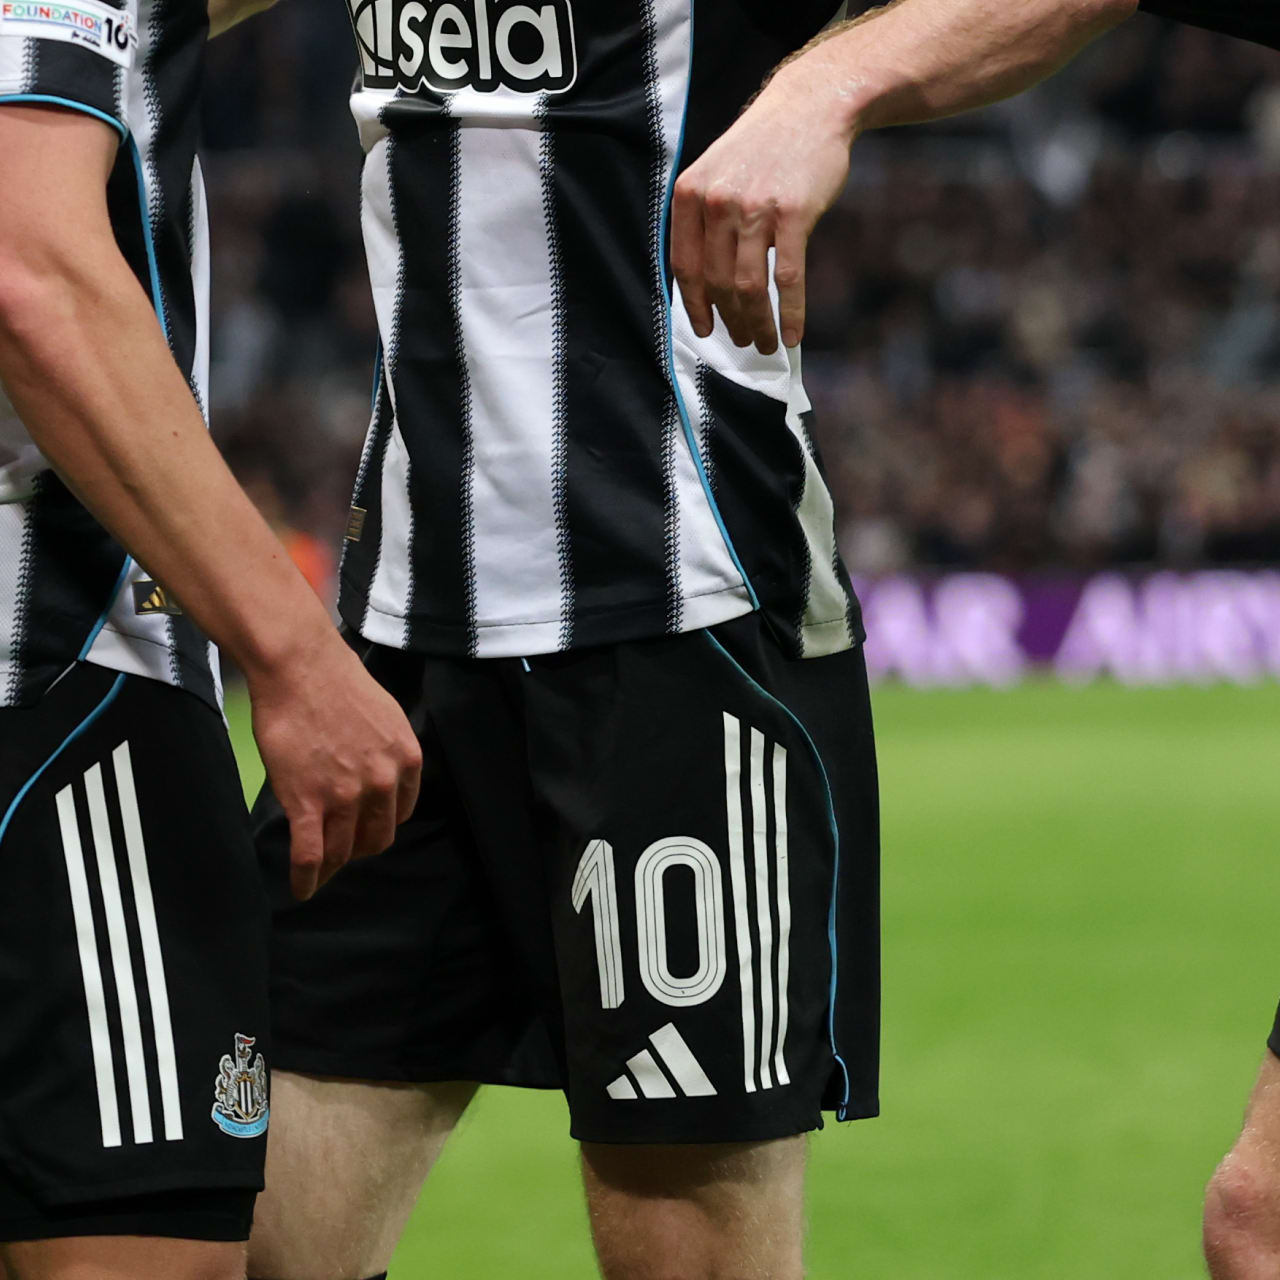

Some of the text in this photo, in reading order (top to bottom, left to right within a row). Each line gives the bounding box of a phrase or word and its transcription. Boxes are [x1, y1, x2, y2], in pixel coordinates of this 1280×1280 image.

[3, 4, 102, 33] FOUNDATION
[854, 572, 1023, 690] AR
[572, 836, 726, 1009] 10
